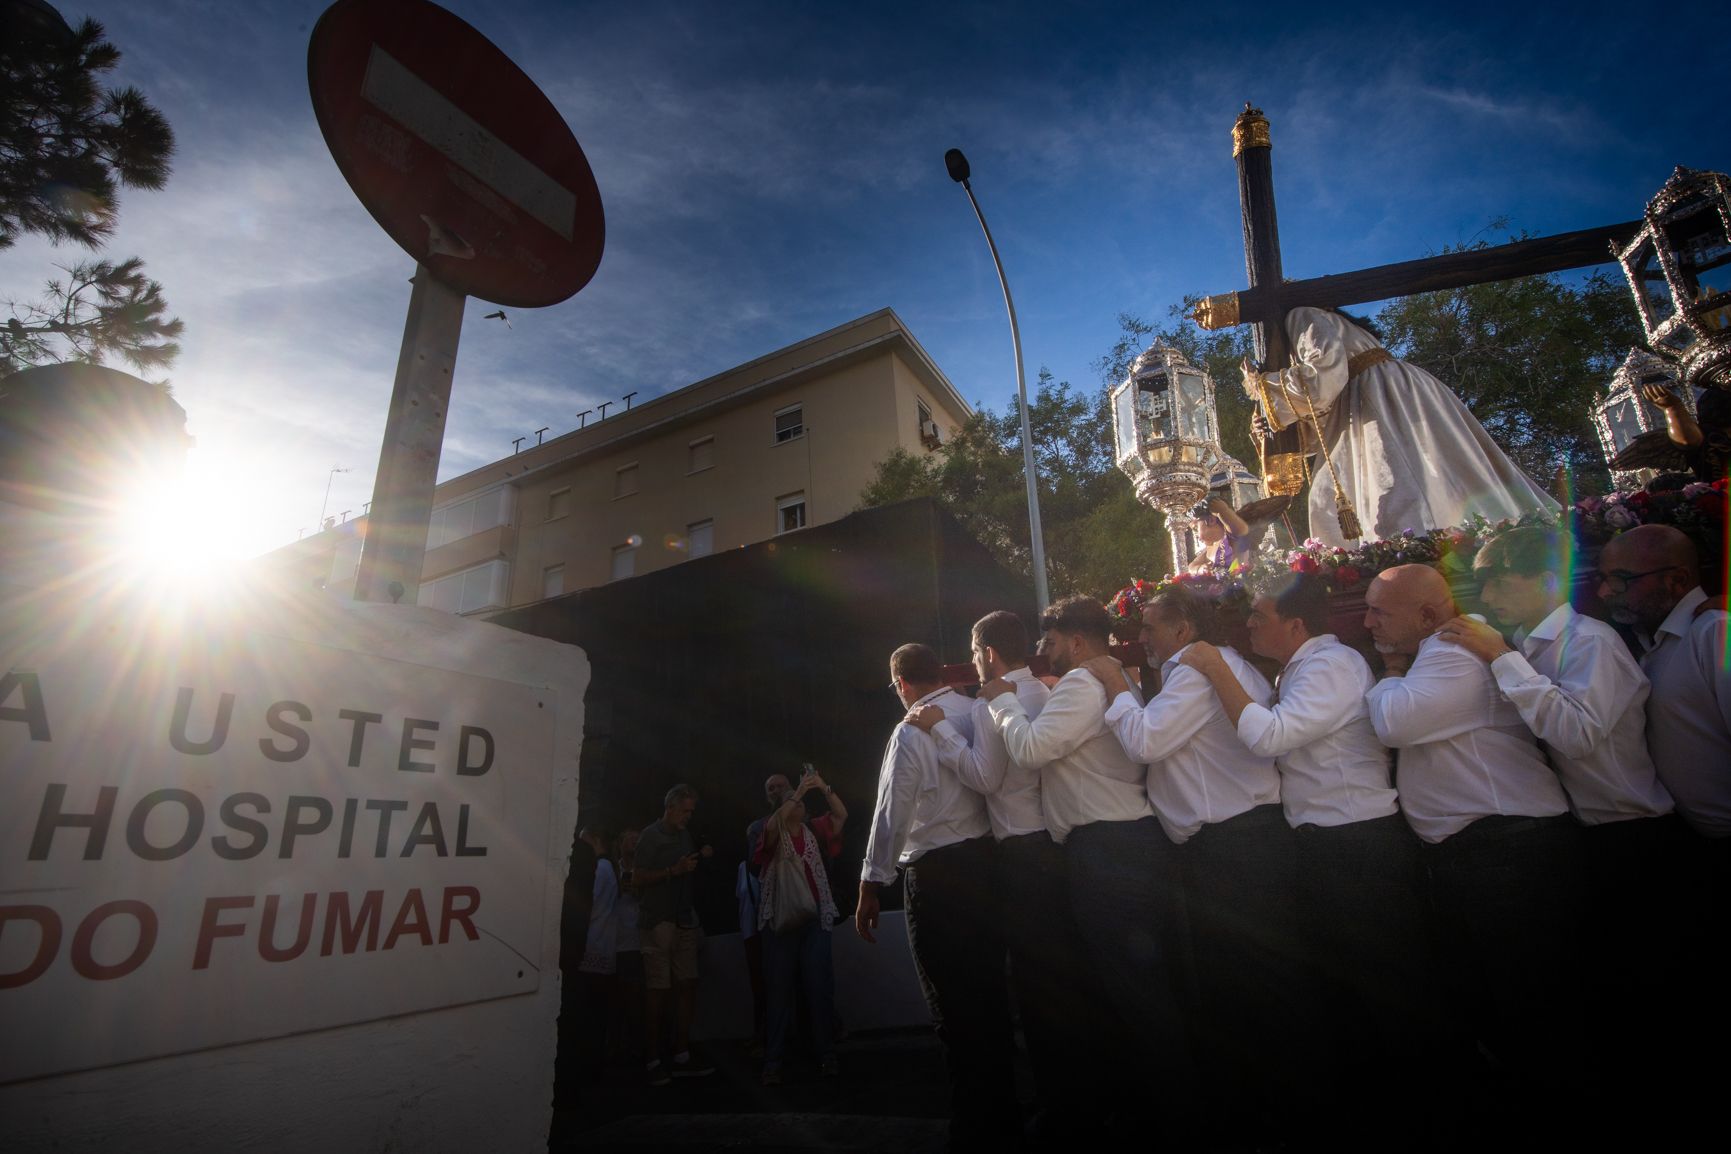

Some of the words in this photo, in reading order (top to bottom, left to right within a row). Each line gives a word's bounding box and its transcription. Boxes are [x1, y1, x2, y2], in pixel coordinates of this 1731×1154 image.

[0, 671, 51, 742] A
[168, 687, 496, 777] USTED
[27, 783, 488, 861] HOSPITAL
[0, 900, 159, 990] DO
[191, 886, 481, 970] FUMAR
